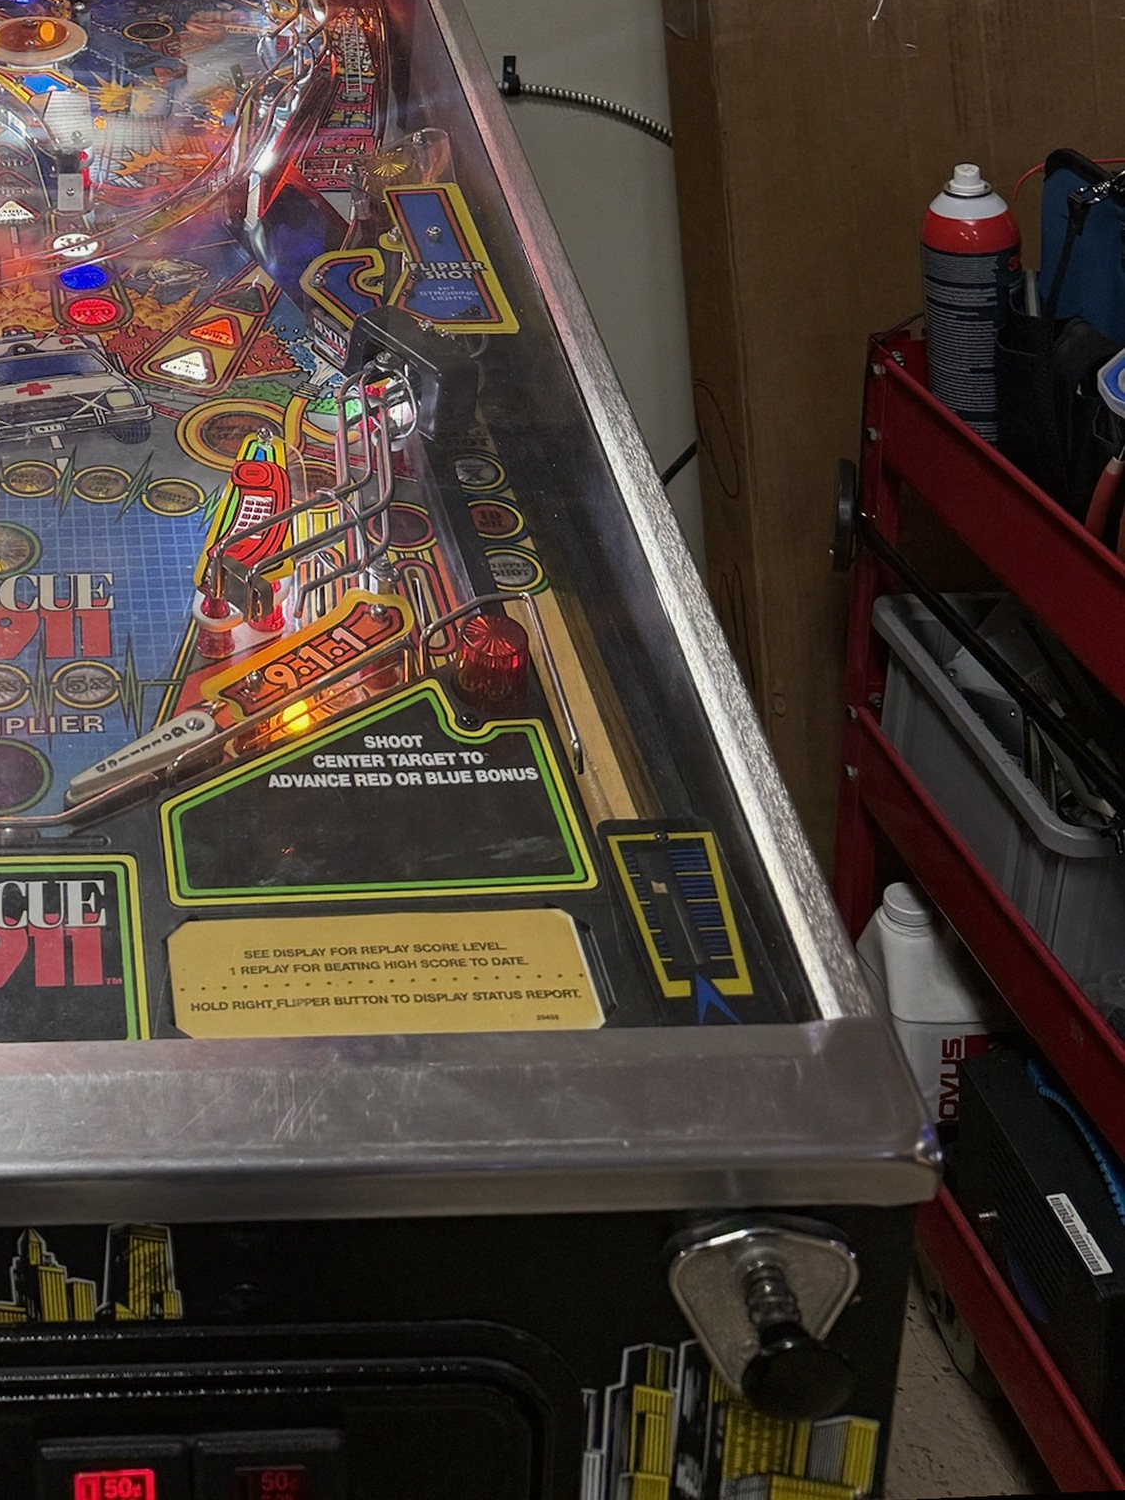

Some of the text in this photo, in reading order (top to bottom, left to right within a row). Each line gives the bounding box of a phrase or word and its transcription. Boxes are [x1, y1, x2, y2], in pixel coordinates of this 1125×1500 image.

[408, 262, 488, 273] FLIPPER
[426, 271, 474, 281] SHOT
[363, 735, 423, 749] SHOOT
[313, 751, 484, 768] CENTER TARGET TO
[268, 766, 539, 788] ADVANCE RED OR BLUE BONUS
[244, 949, 270, 959] SEE
[273, 948, 326, 958] DISPLAY
[330, 946, 357, 956] FOR
[360, 944, 410, 955] REPLAY
[413, 942, 459, 953] SCORE
[228, 956, 529, 976] 1 REPLAY FOR BEATING HIGH SCORE TO DATE.
[190, 988, 582, 1012] HOLD RIGHT FLIPPER BUTTON TO DISPLAY STATUS REPORT.
[939, 1038, 962, 1122] OVUS
